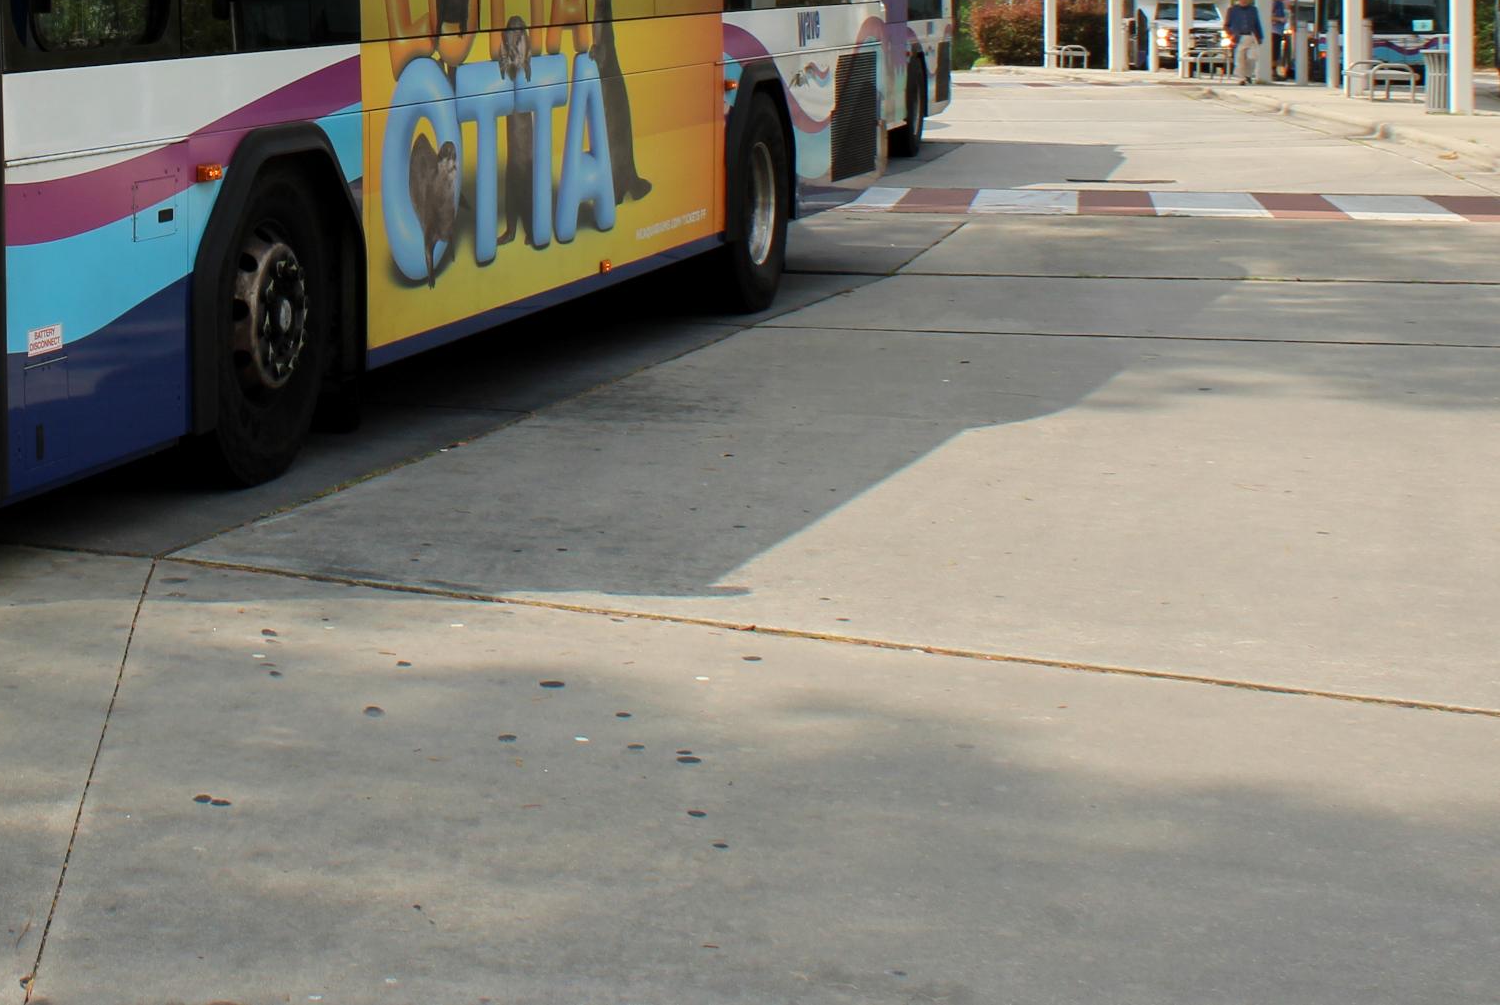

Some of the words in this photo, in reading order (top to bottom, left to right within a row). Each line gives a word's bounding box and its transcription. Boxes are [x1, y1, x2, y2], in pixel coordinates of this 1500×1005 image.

[381, 51, 616, 281] OTTA
[34, 327, 55, 341] BATTERY
[29, 336, 60, 352] DISCONNECT
